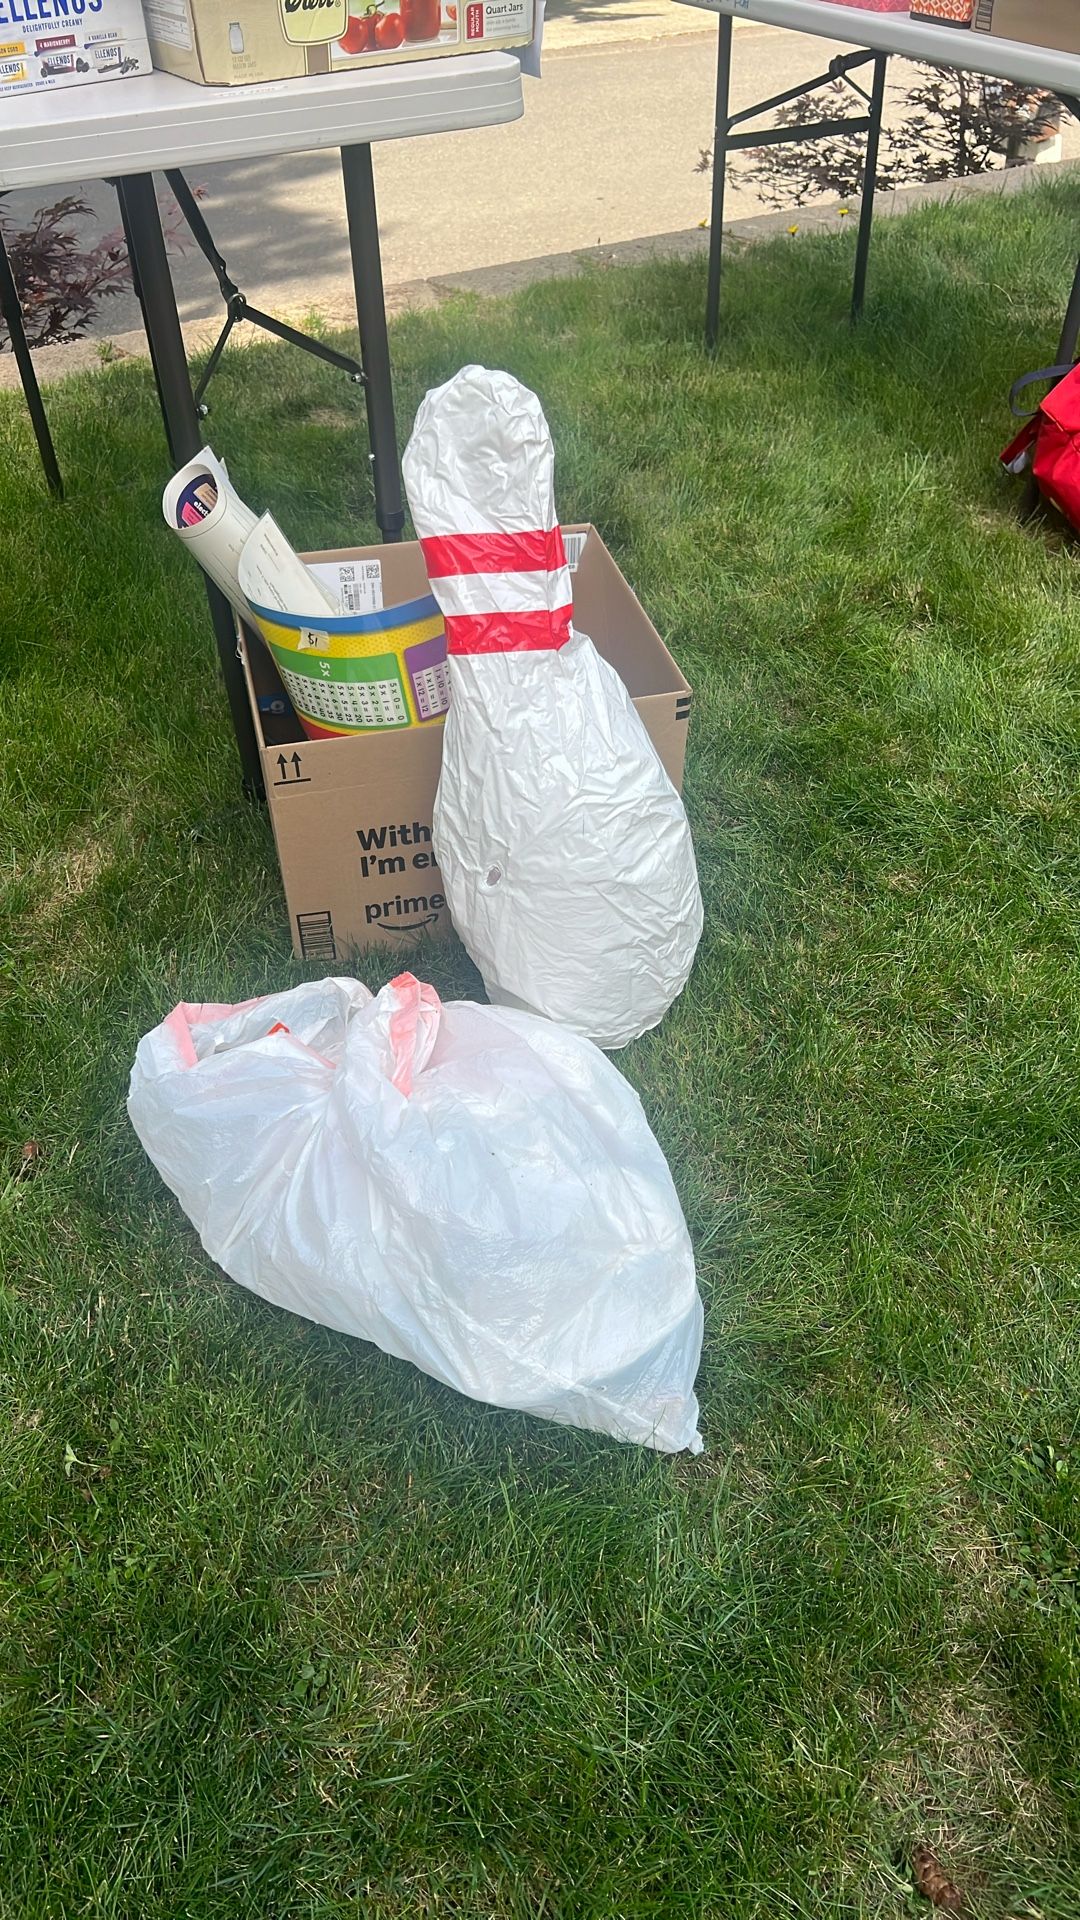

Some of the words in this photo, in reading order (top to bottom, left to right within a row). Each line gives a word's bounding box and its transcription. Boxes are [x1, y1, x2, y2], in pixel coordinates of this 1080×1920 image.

[486, 6, 507, 15] Quart
[508, 3, 523, 12] Jars
[22, 21, 60, 33] DELIGHTFULLY
[61, 18, 83, 28] CREAMY
[47, 55, 70, 65] ELLENOS
[94, 48, 117, 59] ELLENOS
[356, 822, 433, 851] With
[361, 855, 406, 878] I'm
[365, 894, 445, 924] prime
